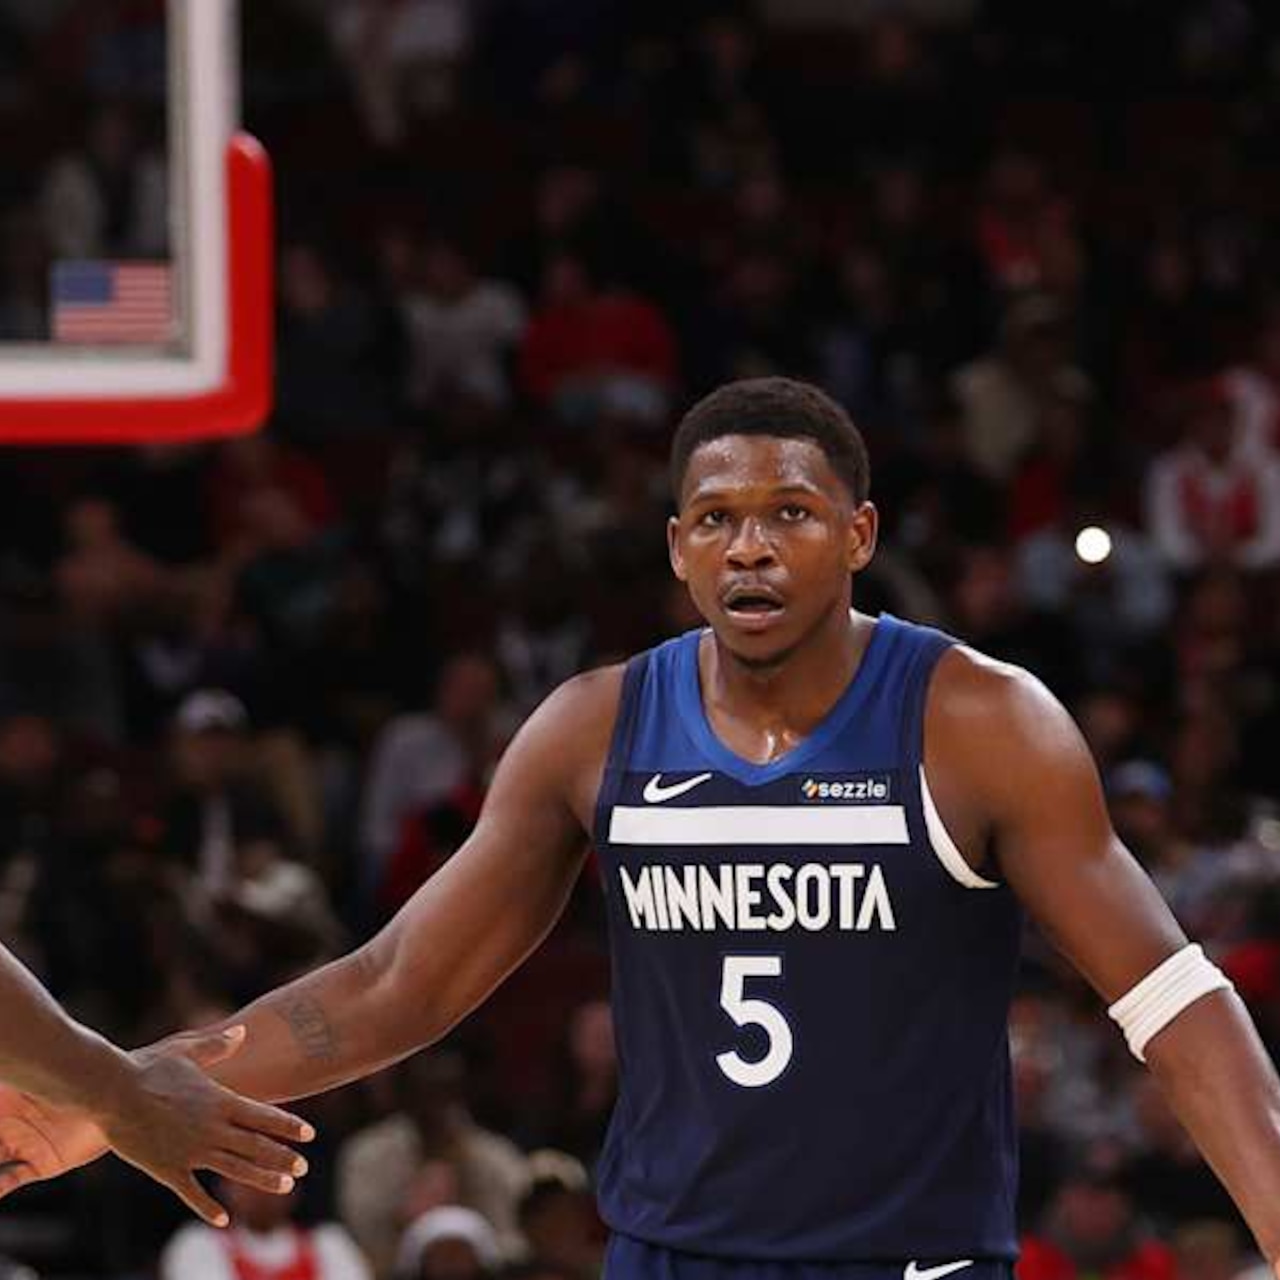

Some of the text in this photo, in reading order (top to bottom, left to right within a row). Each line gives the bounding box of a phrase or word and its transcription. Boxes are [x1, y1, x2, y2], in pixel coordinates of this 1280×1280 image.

[818, 778, 887, 799] sezzle
[619, 863, 896, 931] MINNESOTA
[715, 956, 794, 1087] 5
